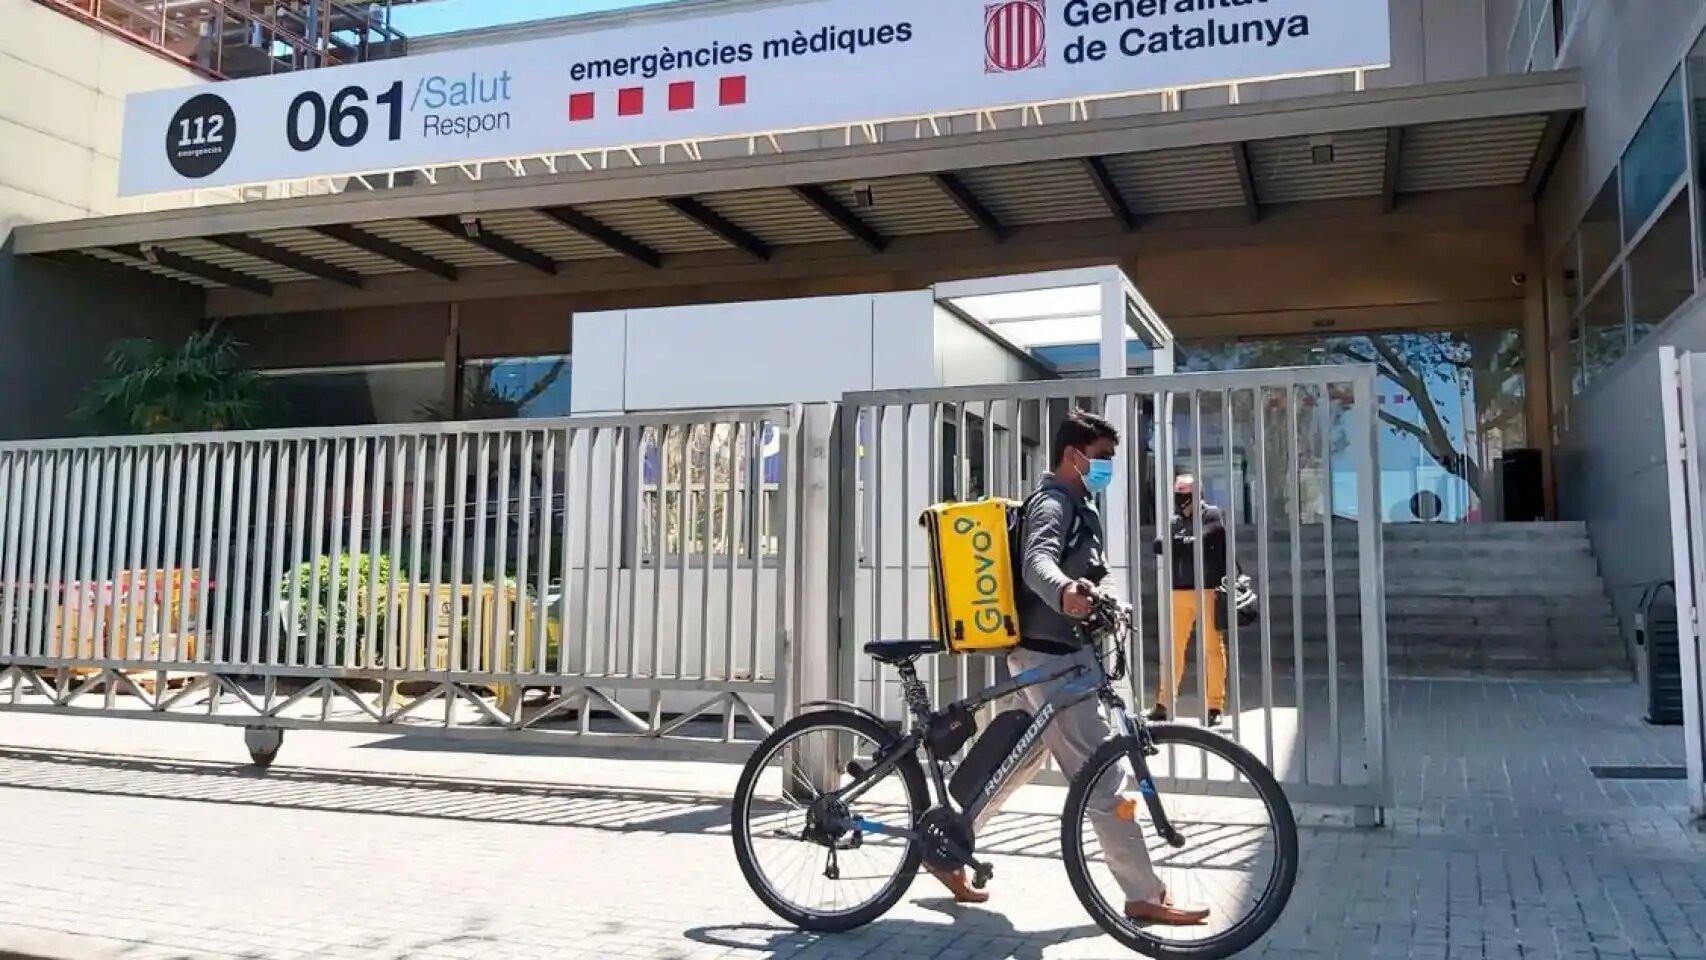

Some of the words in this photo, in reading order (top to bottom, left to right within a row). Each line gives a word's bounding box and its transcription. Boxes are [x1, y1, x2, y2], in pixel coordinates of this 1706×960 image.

[1063, 0, 1268, 27] Genera
[1063, 35, 1107, 64] de
[1119, 14, 1309, 56] Catalunya
[570, 41, 752, 80] emergències
[763, 22, 912, 59] mèdiques
[178, 114, 224, 147] 112
[286, 80, 403, 152] 061
[423, 111, 510, 138] Respon
[970, 530, 1003, 634] Glovo
[984, 702, 1054, 796] ROCKRIDER
